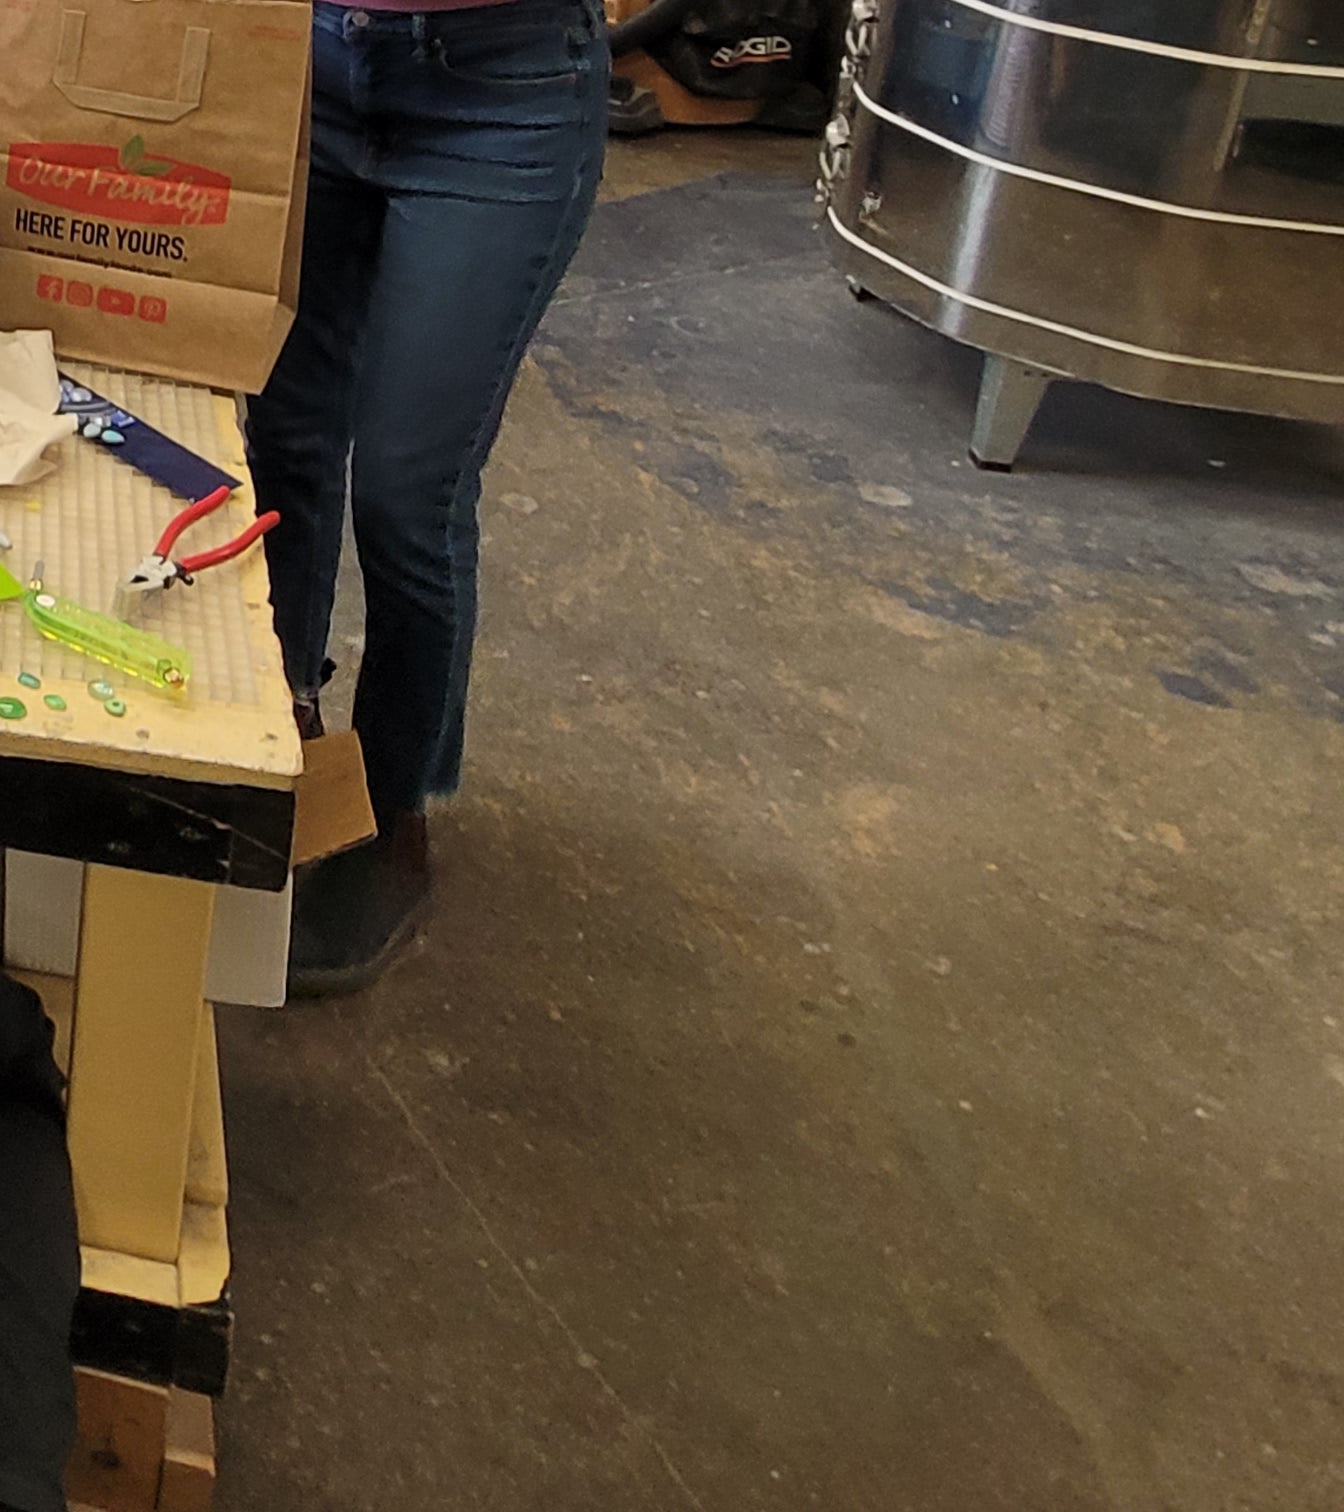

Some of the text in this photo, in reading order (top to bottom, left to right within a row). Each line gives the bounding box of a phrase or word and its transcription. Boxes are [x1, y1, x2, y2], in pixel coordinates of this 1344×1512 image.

[19, 157, 210, 225] Our Family
[15, 208, 188, 262] HERE FOR YOURS.
